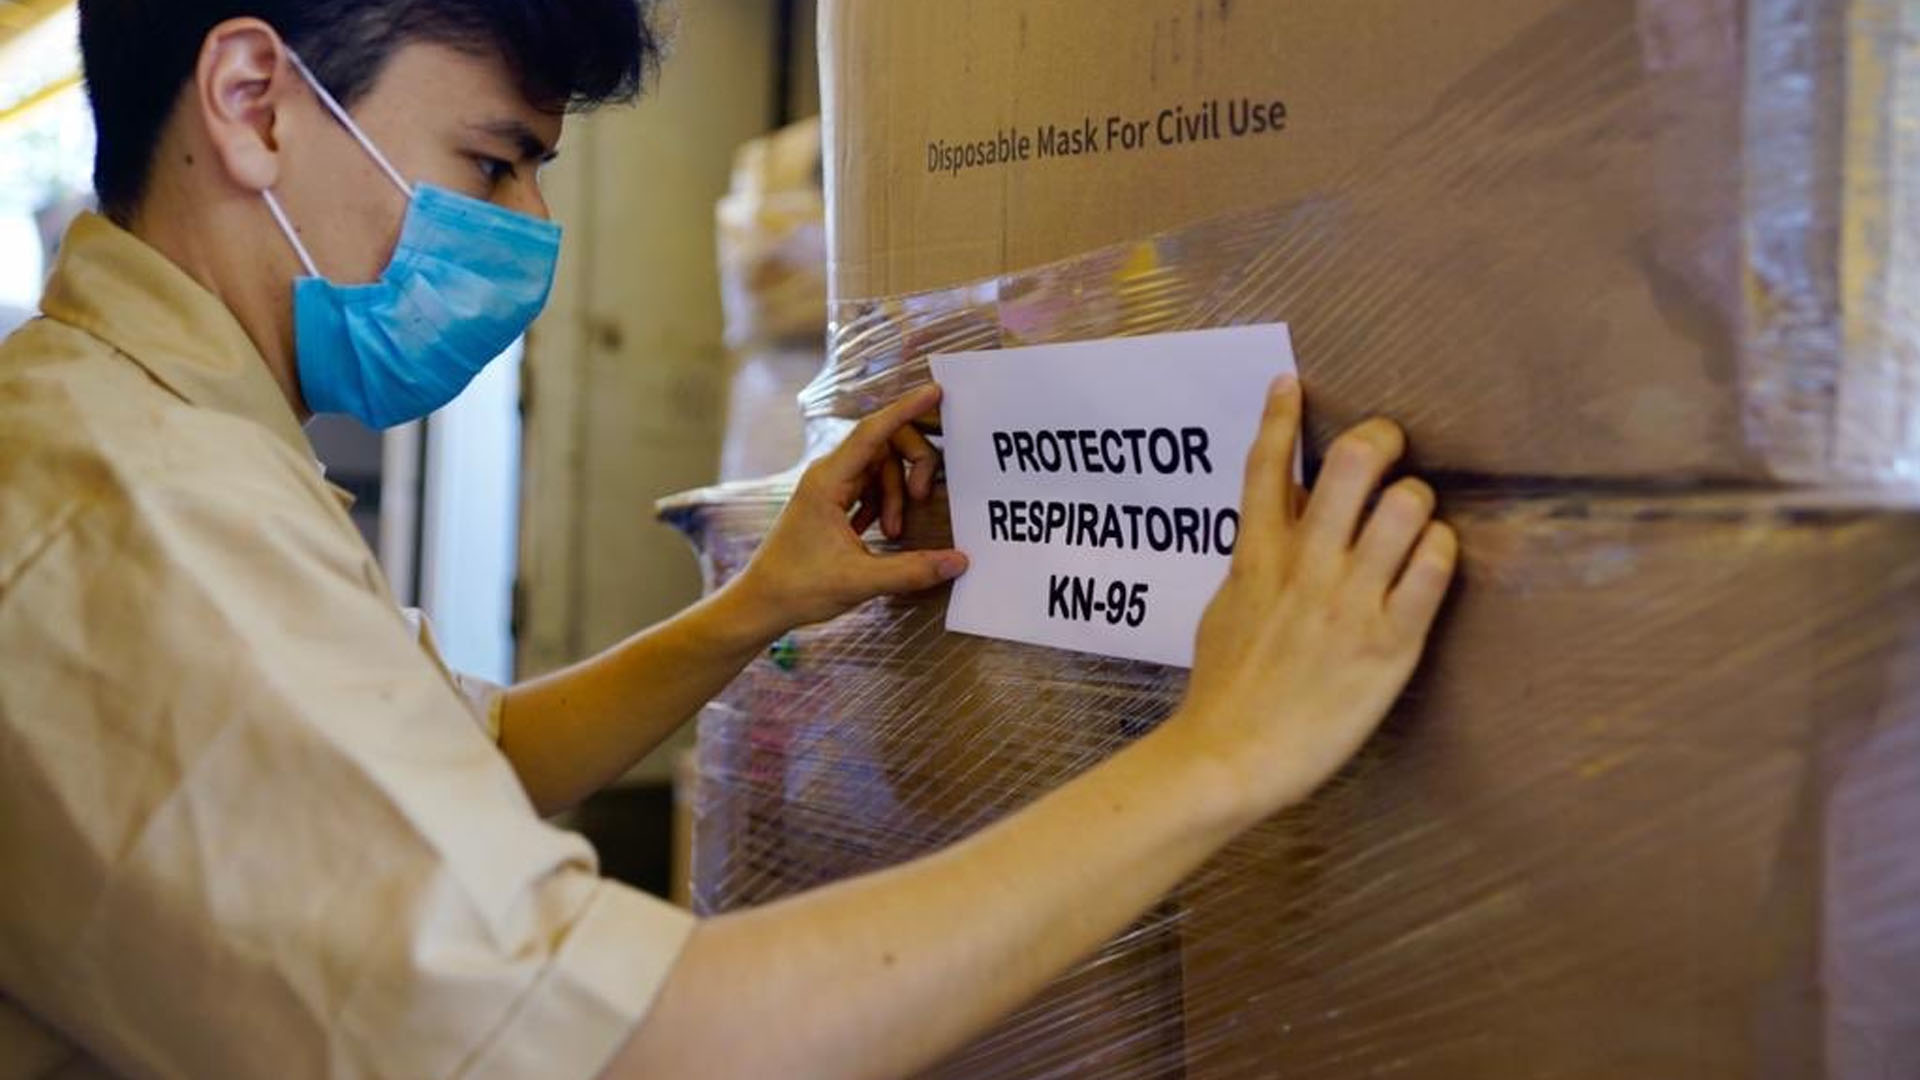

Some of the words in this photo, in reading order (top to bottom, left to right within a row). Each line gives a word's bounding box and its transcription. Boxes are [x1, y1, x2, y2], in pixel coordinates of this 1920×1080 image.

[927, 128, 1030, 177] Disposable
[1037, 118, 1098, 159] Mask
[1106, 117, 1150, 151] For
[1156, 101, 1220, 145] Civil
[1228, 98, 1287, 136] Use
[992, 427, 1213, 475] PROTECTOR
[988, 500, 1240, 556] RESPIRATORIO
[1048, 574, 1149, 627] KN-95
